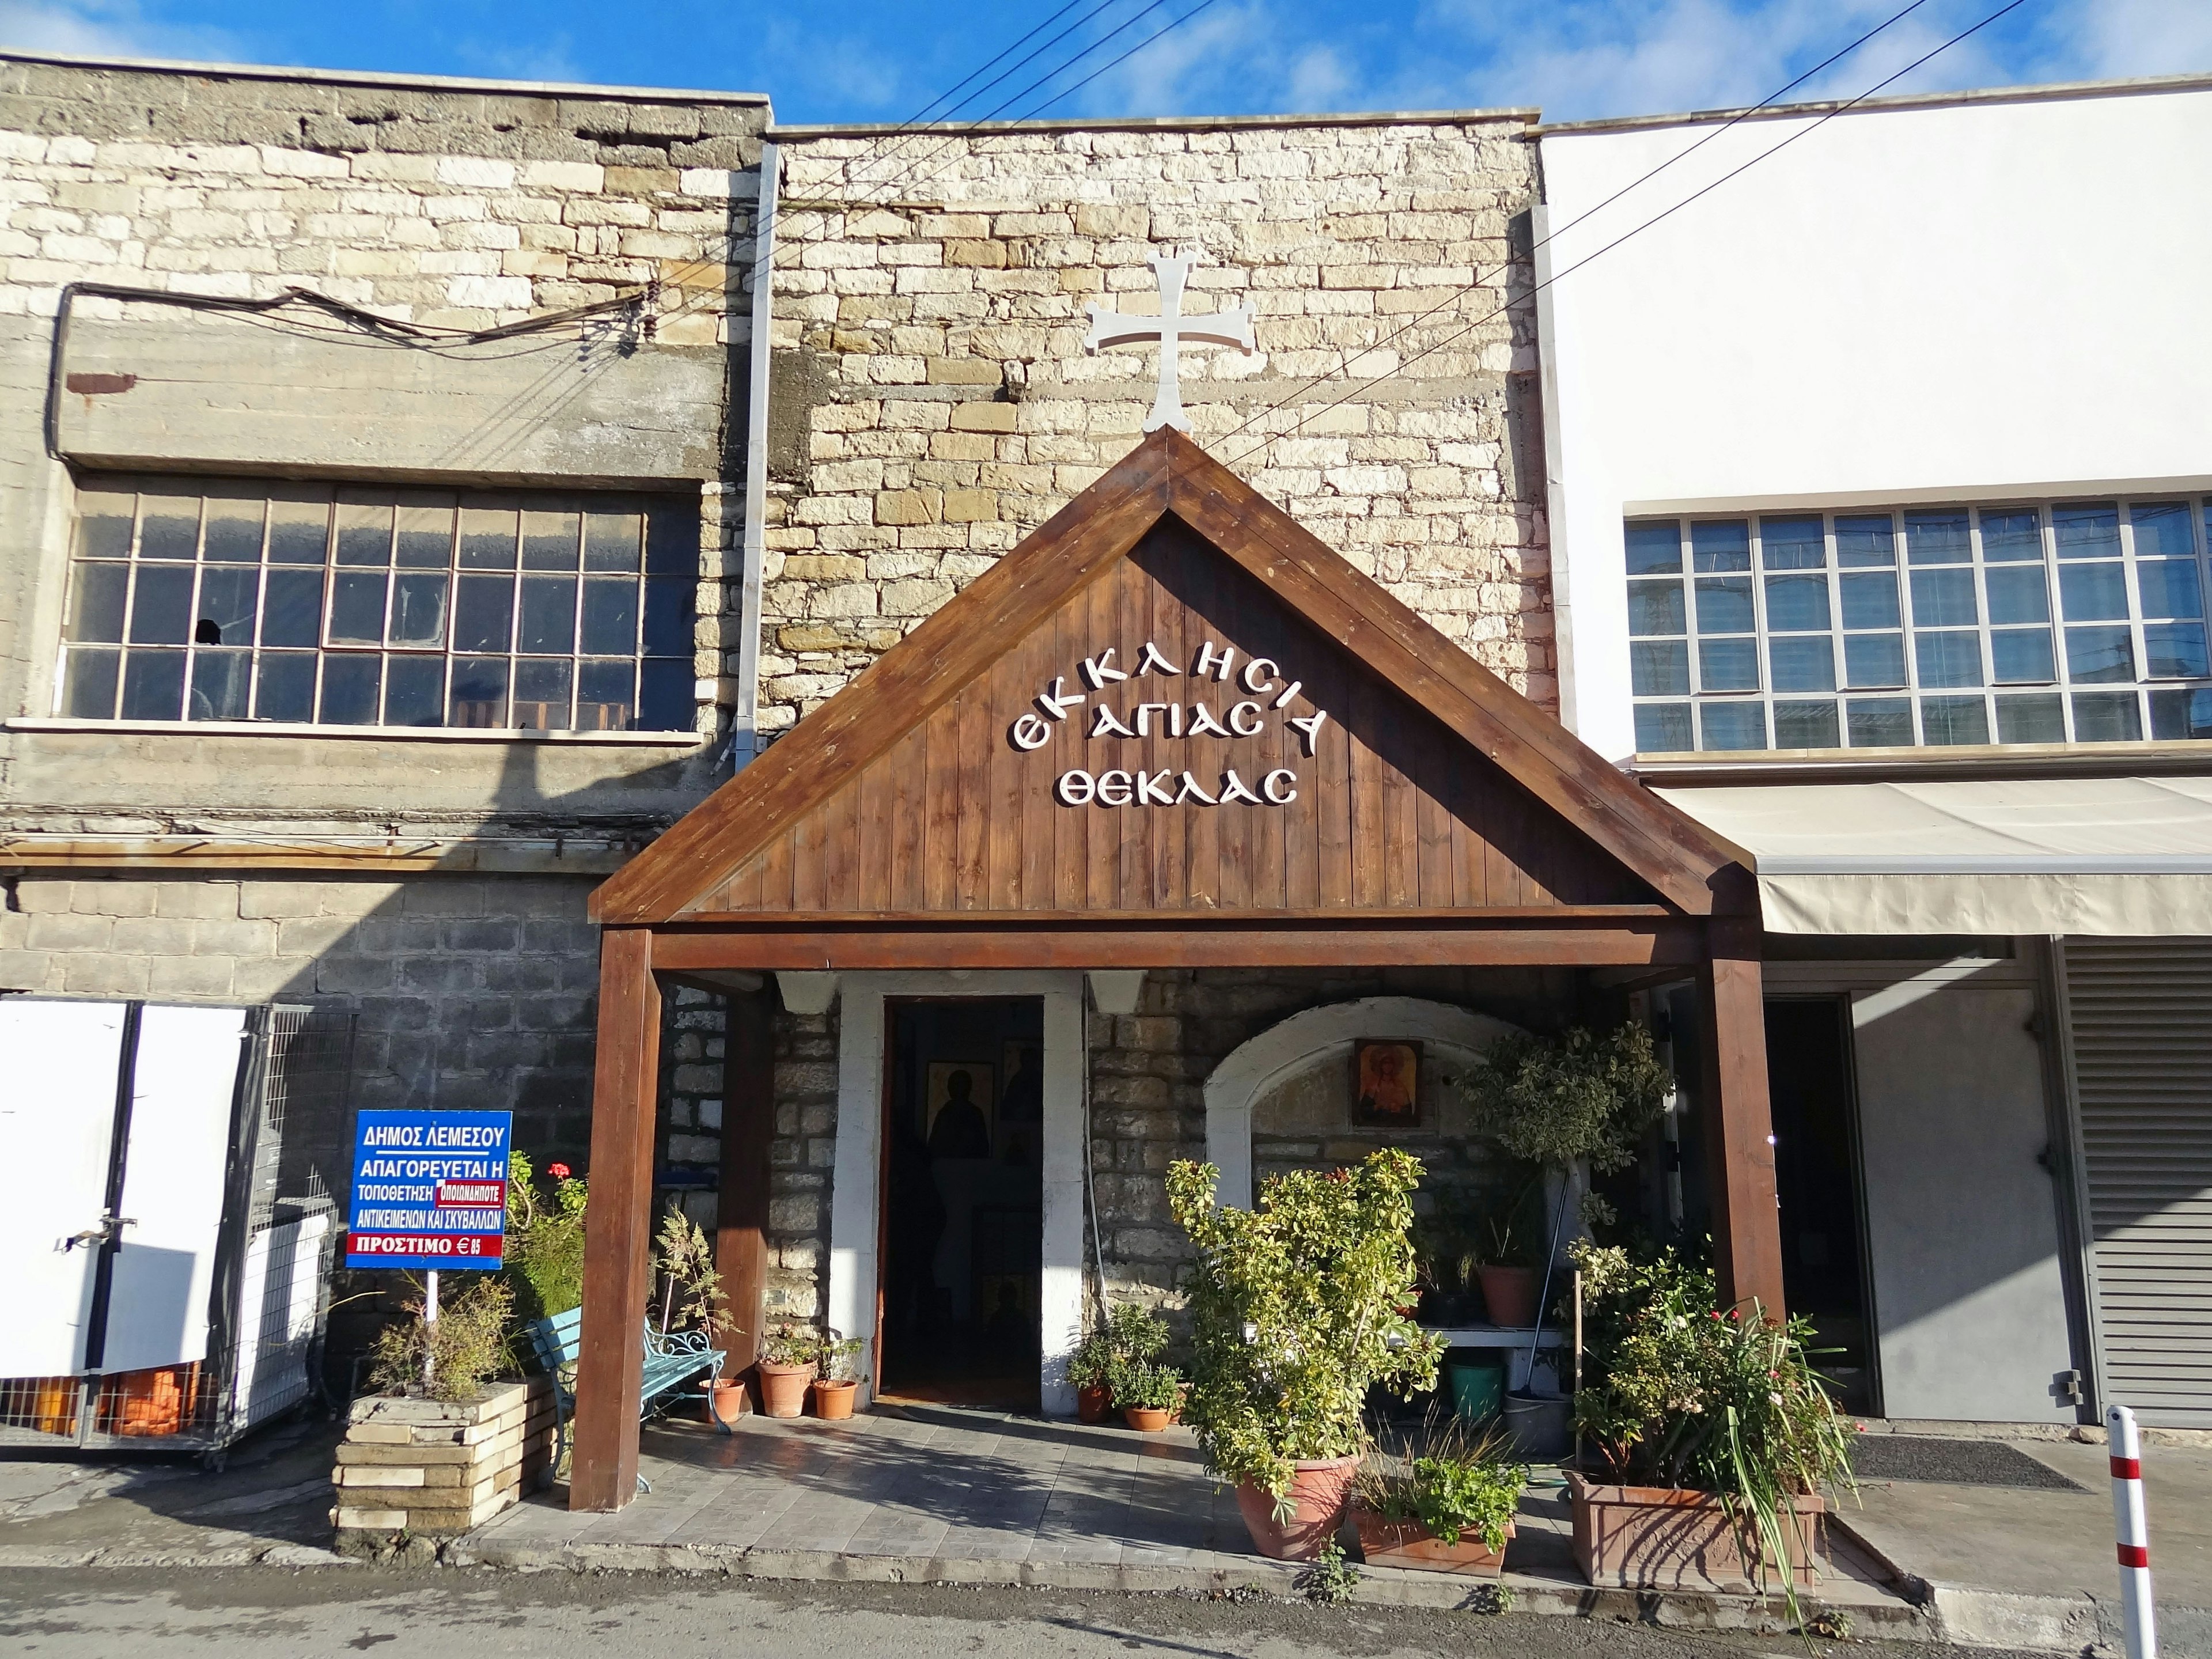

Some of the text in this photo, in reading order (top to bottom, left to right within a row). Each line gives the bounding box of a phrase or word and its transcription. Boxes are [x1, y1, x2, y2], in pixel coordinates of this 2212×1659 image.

[363, 1126, 505, 1147] ΔΗΜΟΣ ΛΕΜΕΣΟΥ
[360, 1160, 503, 1178] ΑΠΑΓΟΡΕΥΕΤΑΙ Η
[358, 1184, 499, 1202] ΤΟΠΟΘΕΤΗΣΗ ΟΠΟΙΩΝΔΗΠΟΤΕ
[357, 1209, 501, 1230] ΑΝΤΙΚΕΙΜΕΝΩΝ ΚΑΙ ΣΚΥΒΑΛΛΩΝ
[356, 1236, 452, 1253] ΠΡΟΣΤΙΜΟ
